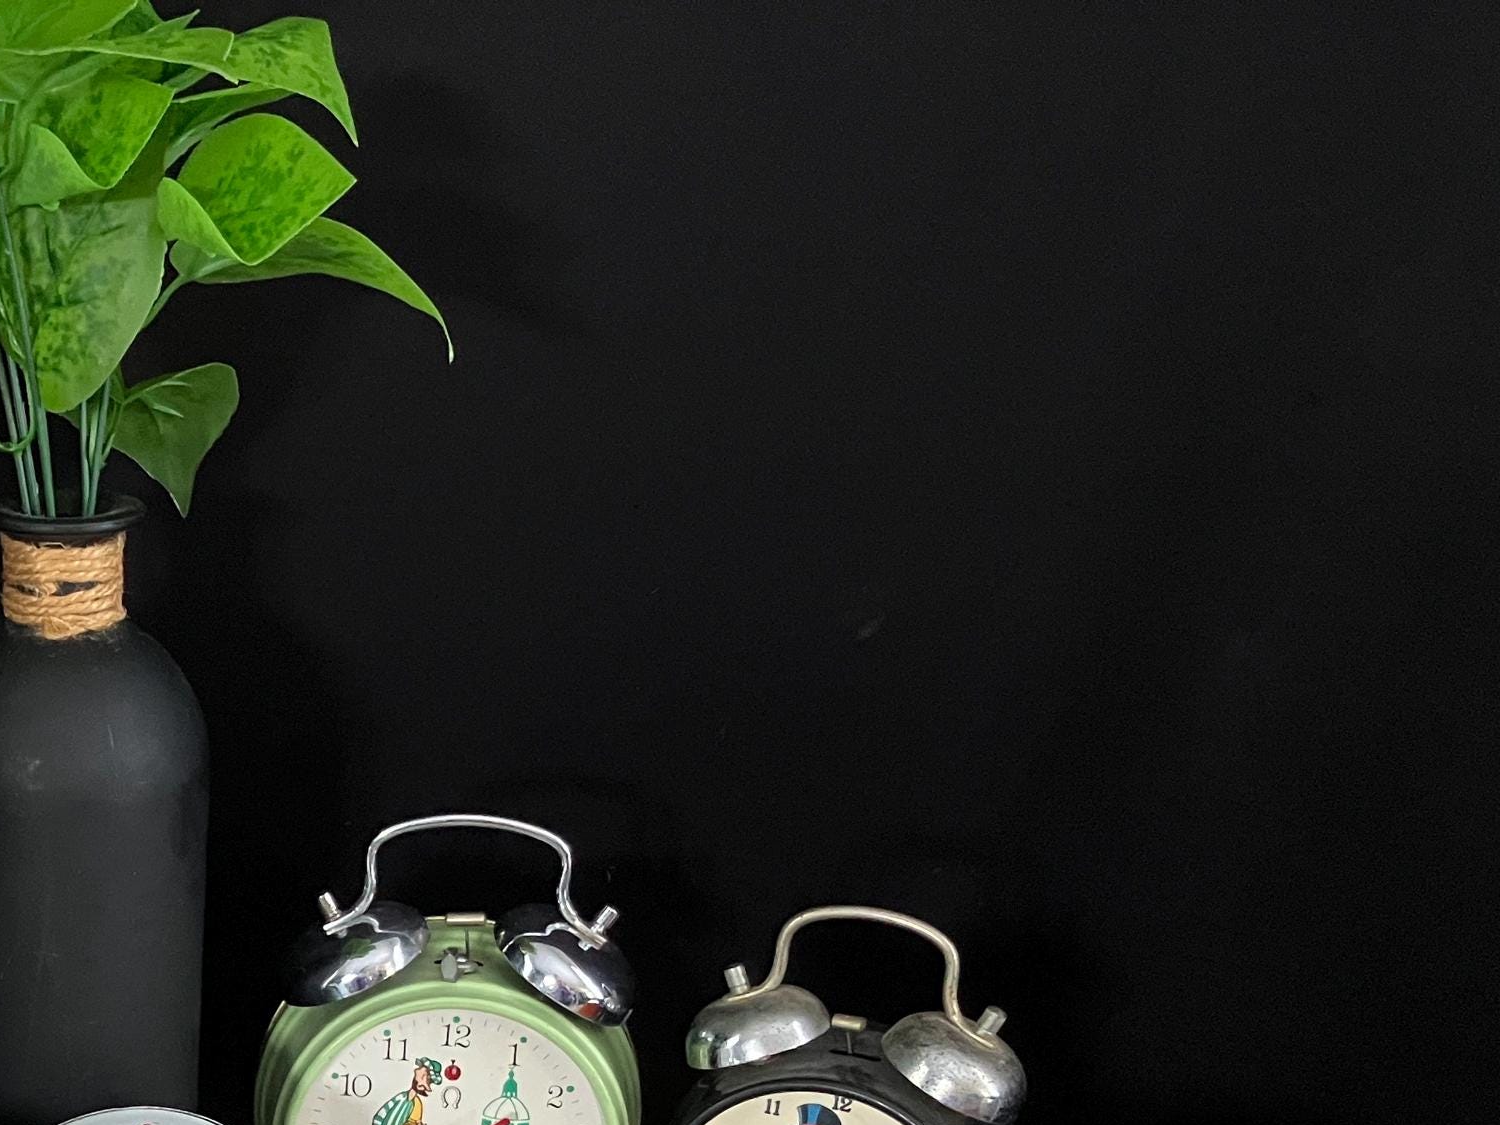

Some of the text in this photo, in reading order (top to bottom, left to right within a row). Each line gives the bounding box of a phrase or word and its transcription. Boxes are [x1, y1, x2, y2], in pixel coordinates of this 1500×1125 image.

[442, 1024, 471, 1048] 12
[383, 1039, 408, 1061] 11
[509, 1044, 521, 1066] 1
[339, 1074, 372, 1097] 10
[546, 1085, 564, 1108] 2
[764, 1099, 780, 1116] 11
[832, 1096, 852, 1113] 12
